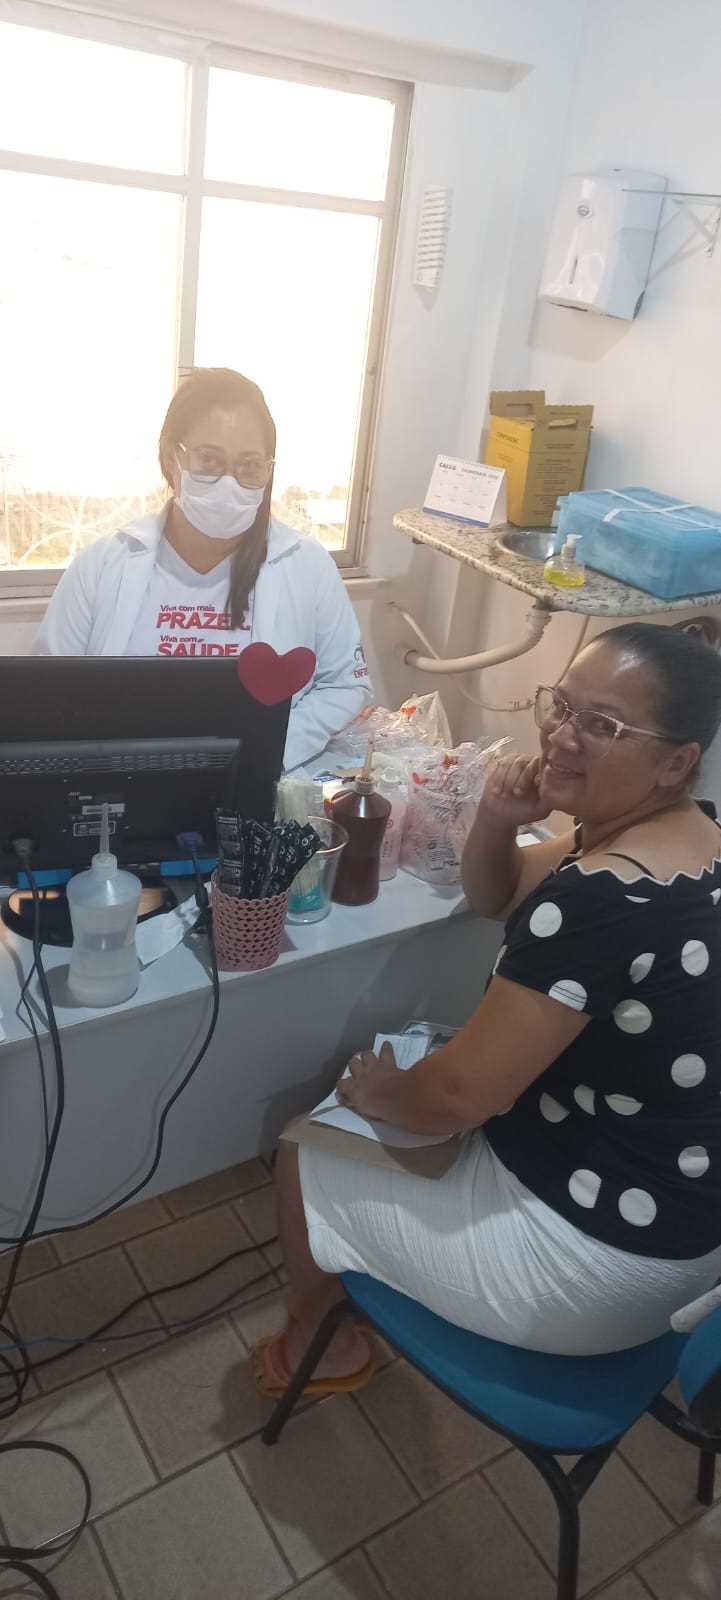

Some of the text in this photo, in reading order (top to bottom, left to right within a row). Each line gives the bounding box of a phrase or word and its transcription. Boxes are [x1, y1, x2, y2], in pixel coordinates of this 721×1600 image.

[160, 604, 177, 612] Viva
[196, 604, 215, 612] mais
[156, 612, 250, 630] PRAZE
[160, 635, 178, 643] Viva
